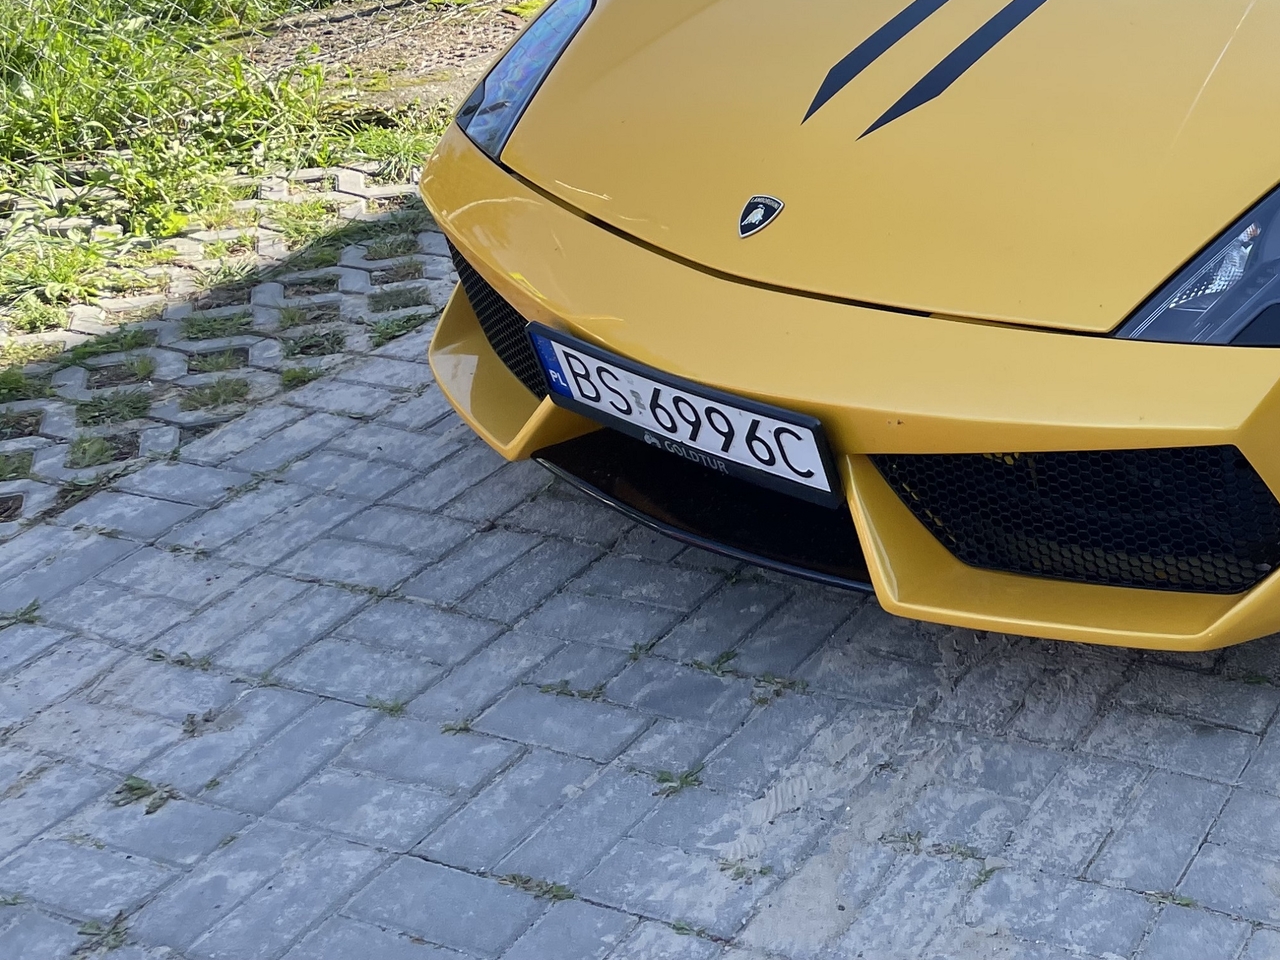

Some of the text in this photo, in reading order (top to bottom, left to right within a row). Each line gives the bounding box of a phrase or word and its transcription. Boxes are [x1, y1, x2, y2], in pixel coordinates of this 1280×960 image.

[549, 368, 567, 387] PL
[562, 349, 815, 479] BS 6996C
[664, 440, 729, 475] GOLDTUR
